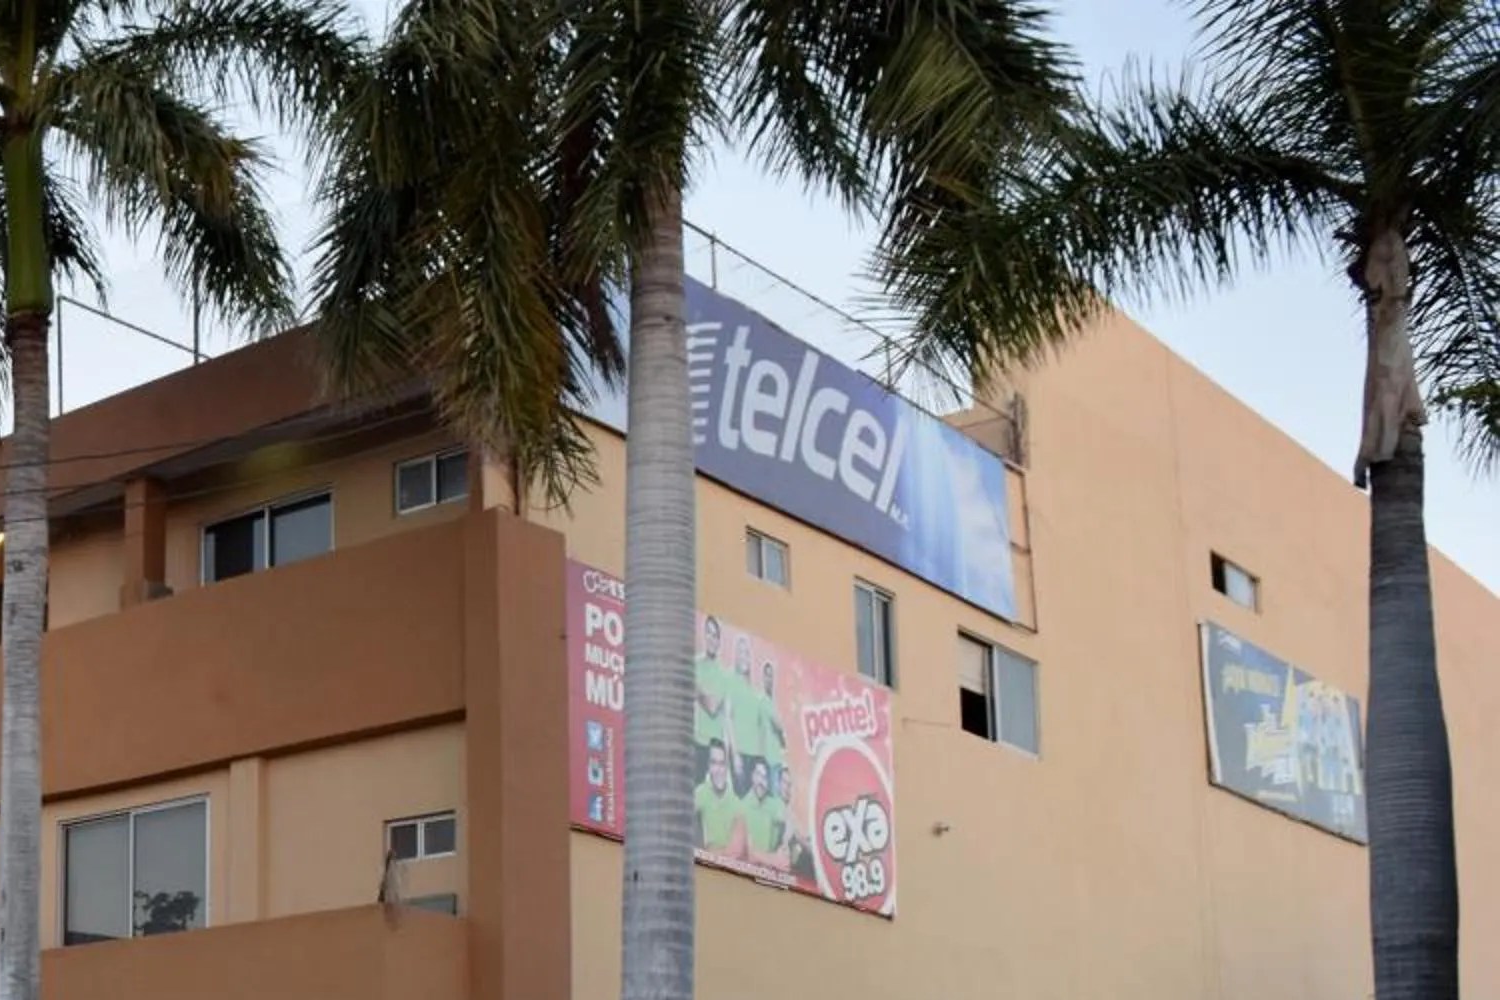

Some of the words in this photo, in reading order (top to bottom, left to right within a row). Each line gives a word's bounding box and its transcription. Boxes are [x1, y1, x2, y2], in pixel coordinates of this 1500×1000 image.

[718, 325, 908, 515] telcel
[585, 602, 624, 647] PO
[585, 668, 624, 711] MÚ
